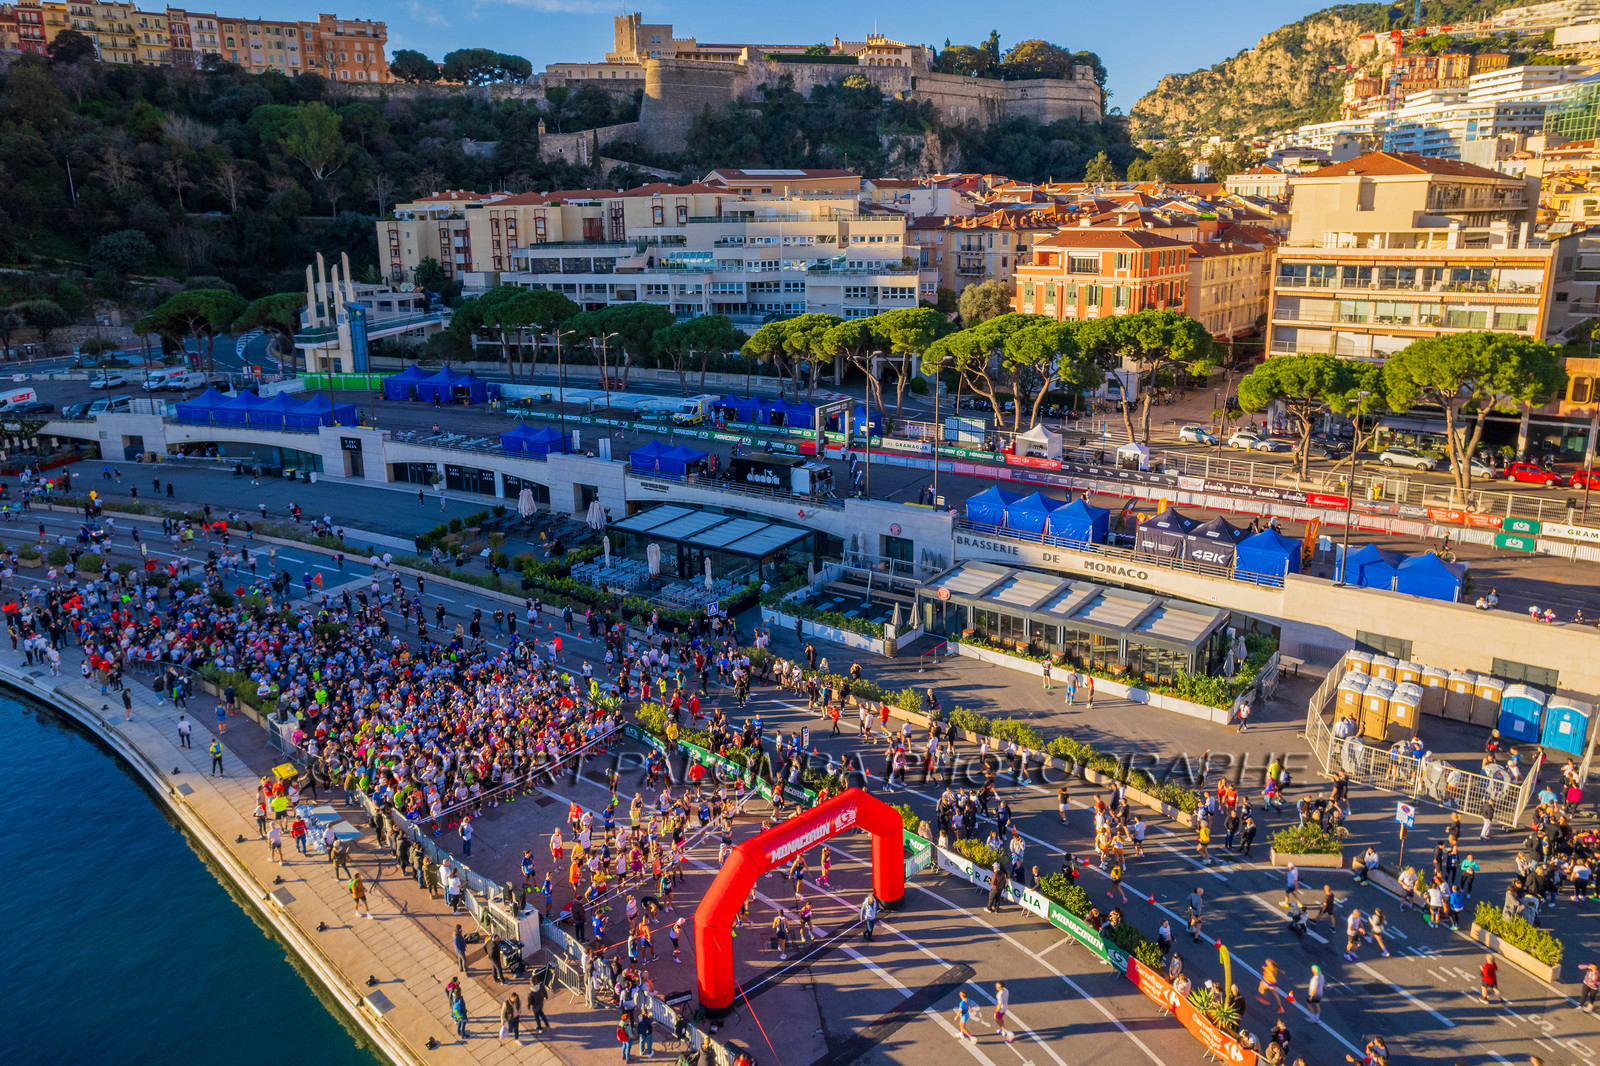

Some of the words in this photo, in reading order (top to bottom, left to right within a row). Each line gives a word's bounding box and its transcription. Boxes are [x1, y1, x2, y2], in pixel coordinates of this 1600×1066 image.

[895, 442, 928, 451] GRAMAGLIA
[956, 535, 1020, 556] BRASSERIE
[1042, 552, 1060, 564] DE
[1083, 560, 1149, 581] MONACO
[1191, 550, 1226, 564] 42K
[966, 866, 1042, 910] GRAAGLIA
[1051, 909, 1105, 952] MONACORUN
[1135, 964, 1164, 991] Carrefour
[1141, 978, 1162, 997] market
[1192, 1013, 1223, 1044] Carrefour
[1199, 1028, 1221, 1049] market
